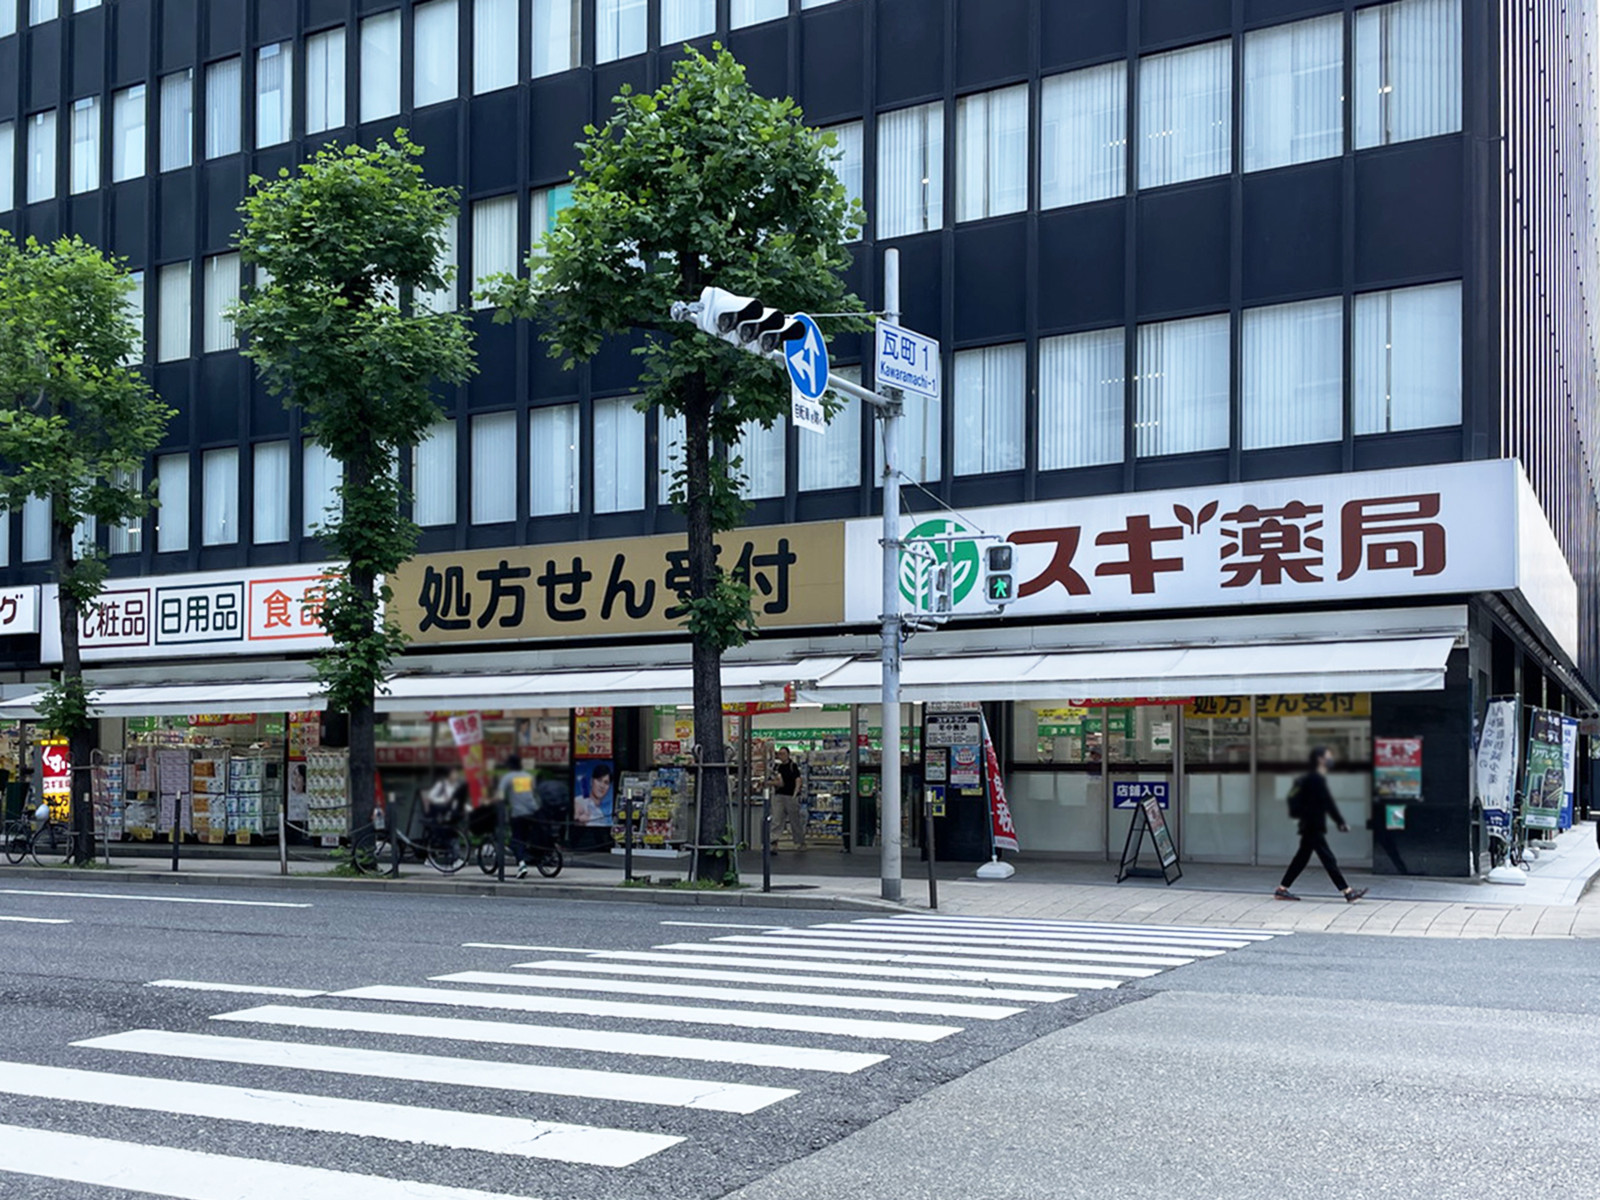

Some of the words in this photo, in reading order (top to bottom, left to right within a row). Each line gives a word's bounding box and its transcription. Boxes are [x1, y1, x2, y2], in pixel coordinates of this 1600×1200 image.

[880, 361, 936, 391] Kawaramachi-1
[1007, 493, 1447, 596] スギ薬局
[161, 593, 237, 634] 日用品
[1116, 784, 1166, 797] 店舗入口
